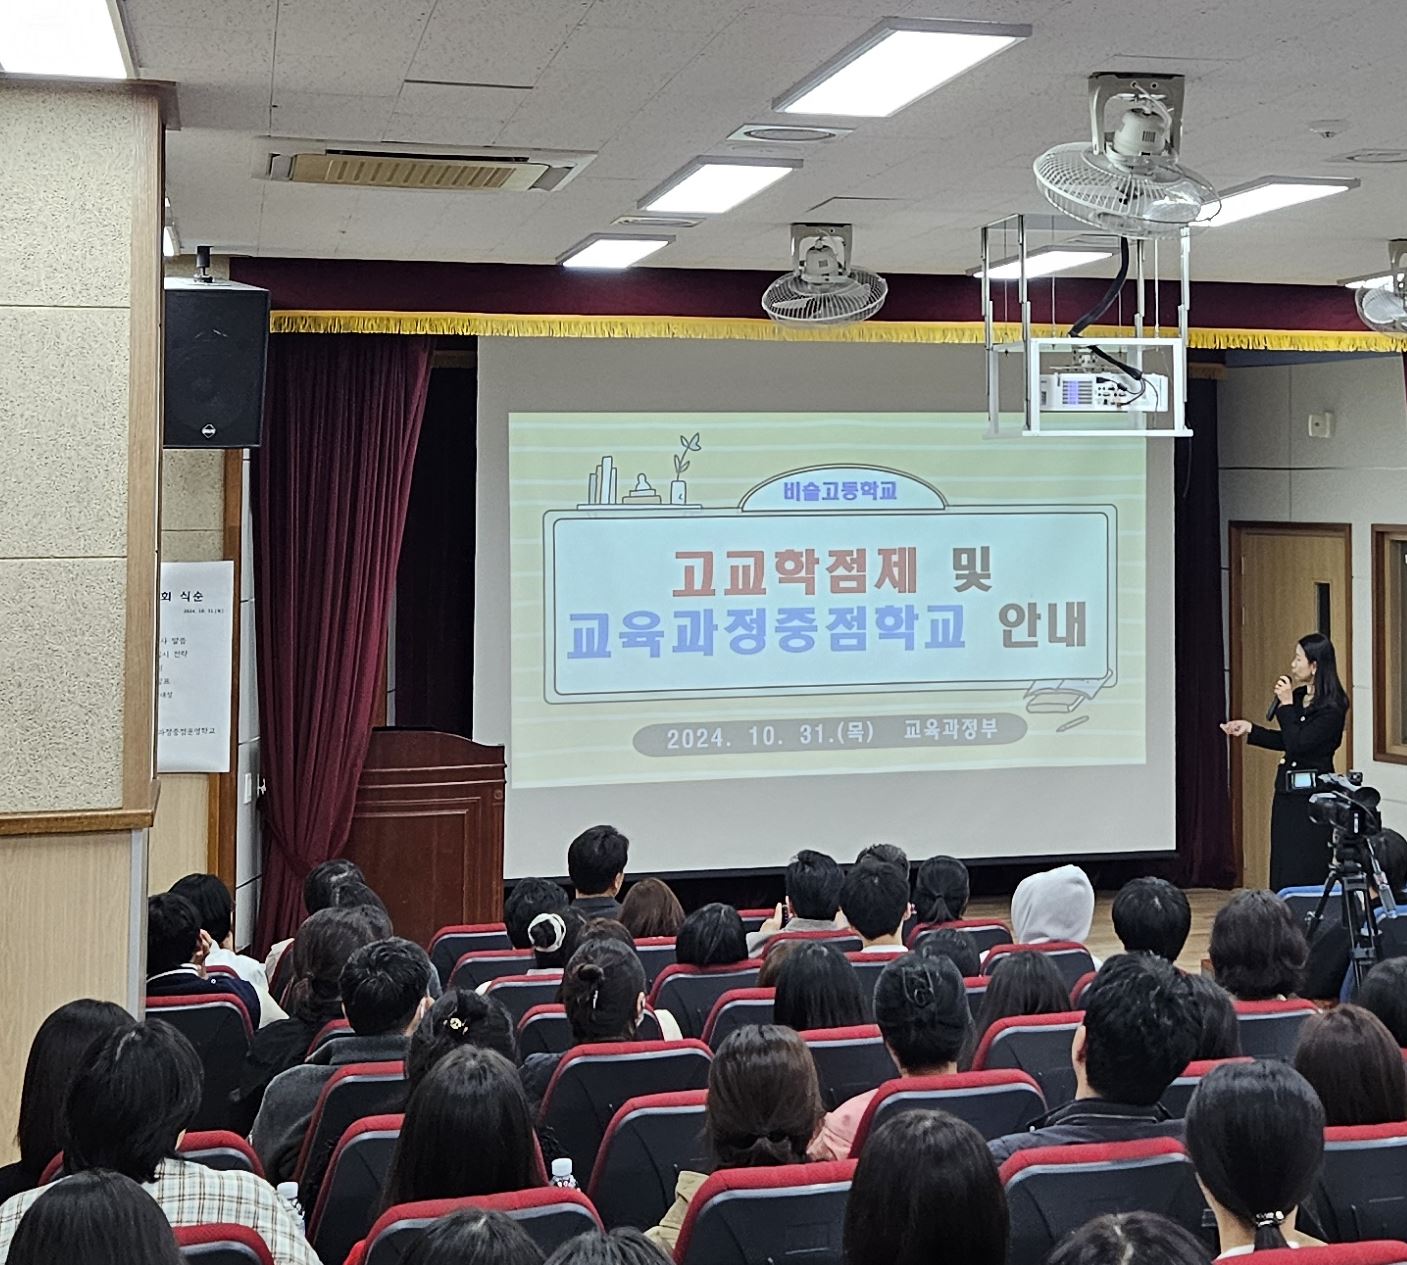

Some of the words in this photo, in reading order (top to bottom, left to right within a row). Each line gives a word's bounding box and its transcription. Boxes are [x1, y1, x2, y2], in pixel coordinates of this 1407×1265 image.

[783, 480, 898, 502] 비술고등학교
[672, 546, 917, 597] 고교학점제
[952, 546, 993, 592] 및
[180, 591, 204, 602] 식순
[567, 604, 966, 659] 교육과정중점학교
[998, 601, 1087, 648] 안내
[667, 728, 731, 750] 2024.
[749, 725, 783, 746] 10.
[800, 720, 874, 744] 31.(목)
[904, 718, 998, 740] 교육과정부
